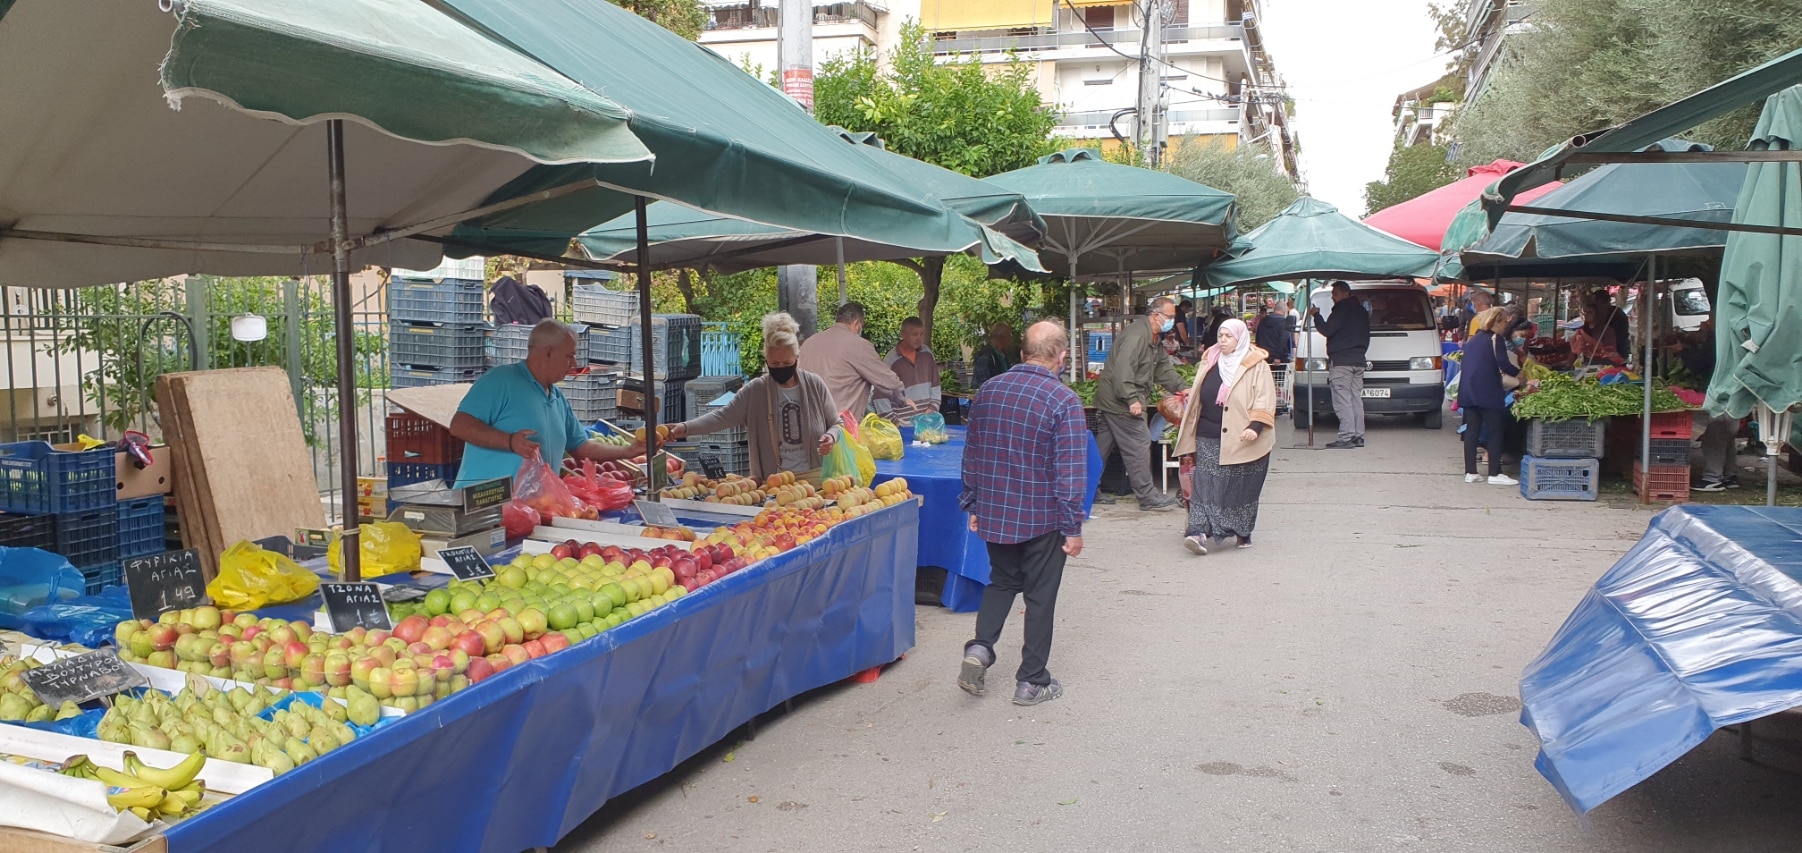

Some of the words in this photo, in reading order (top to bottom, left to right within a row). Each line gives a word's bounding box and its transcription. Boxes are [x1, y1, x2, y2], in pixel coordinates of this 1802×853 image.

[130, 551, 193, 572] ΦΥΡΙΚΙΑ
[151, 563, 197, 581] ΑΓΙΑΣ
[328, 584, 372, 593] ΤΖΟΝΑ
[346, 595, 380, 604] ΑΓΙΑΣ
[50, 662, 126, 688] ΤΥΡΝΑΒΟΥ
